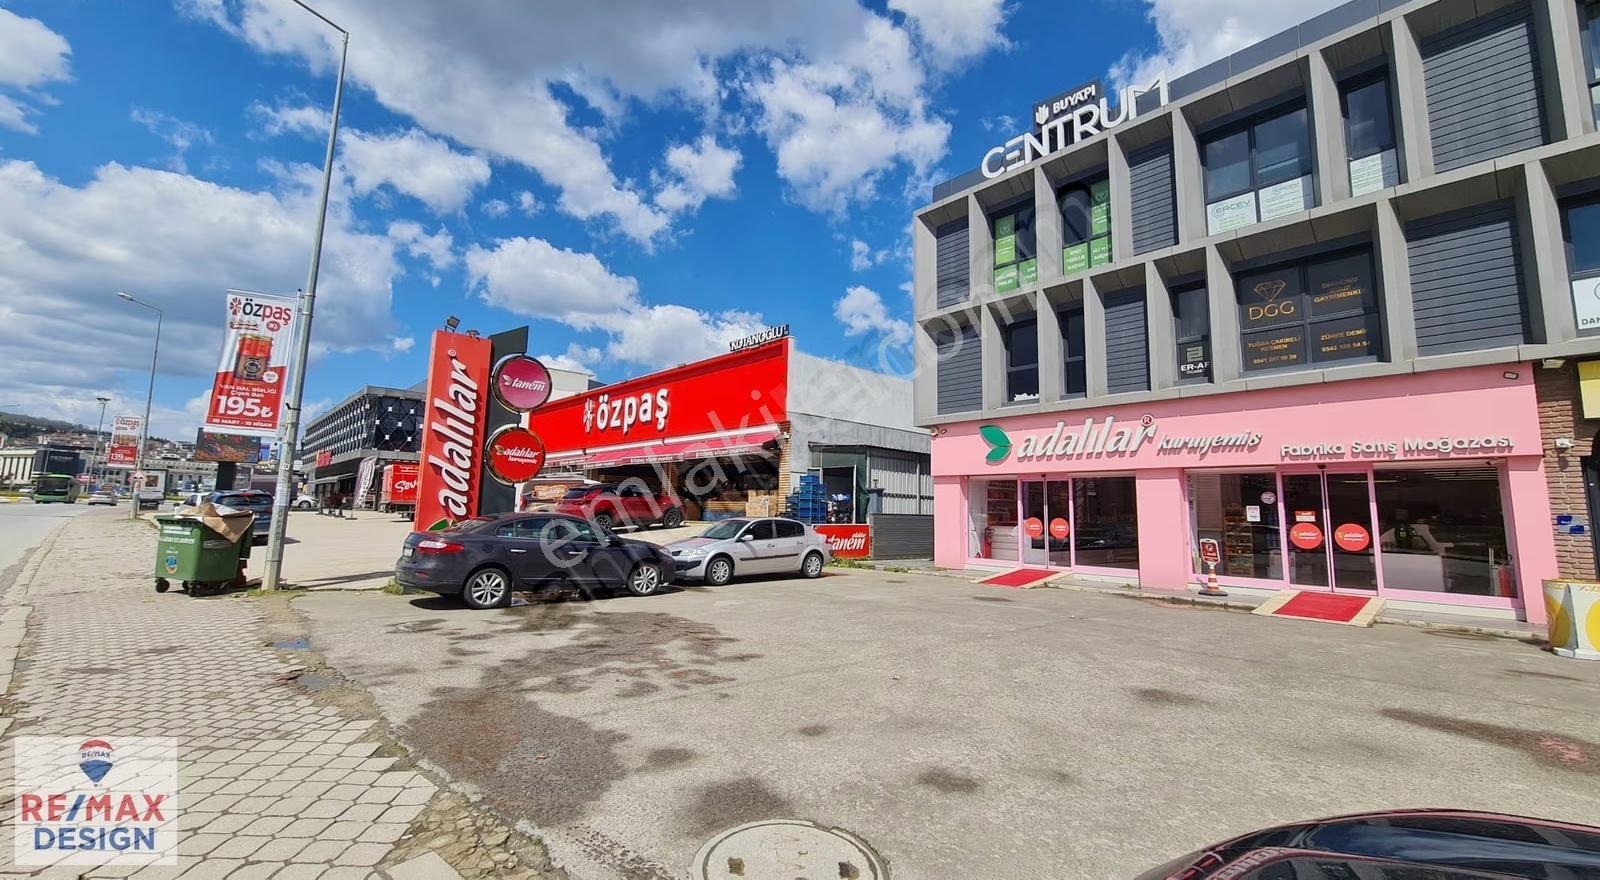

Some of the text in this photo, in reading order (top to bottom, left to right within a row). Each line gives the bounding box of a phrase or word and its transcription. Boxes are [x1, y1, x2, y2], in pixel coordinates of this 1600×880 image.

[1052, 84, 1096, 114] BUYAPI
[981, 75, 1170, 179] CENTRUM
[242, 298, 291, 326] özpaş
[1249, 300, 1295, 320] DGG
[216, 395, 274, 418] 195₺
[596, 387, 669, 433] özpaş
[503, 446, 540, 459] adalılar
[1280, 433, 1515, 458] Fabrika Satış Mağazası
[827, 534, 867, 551] tanem
